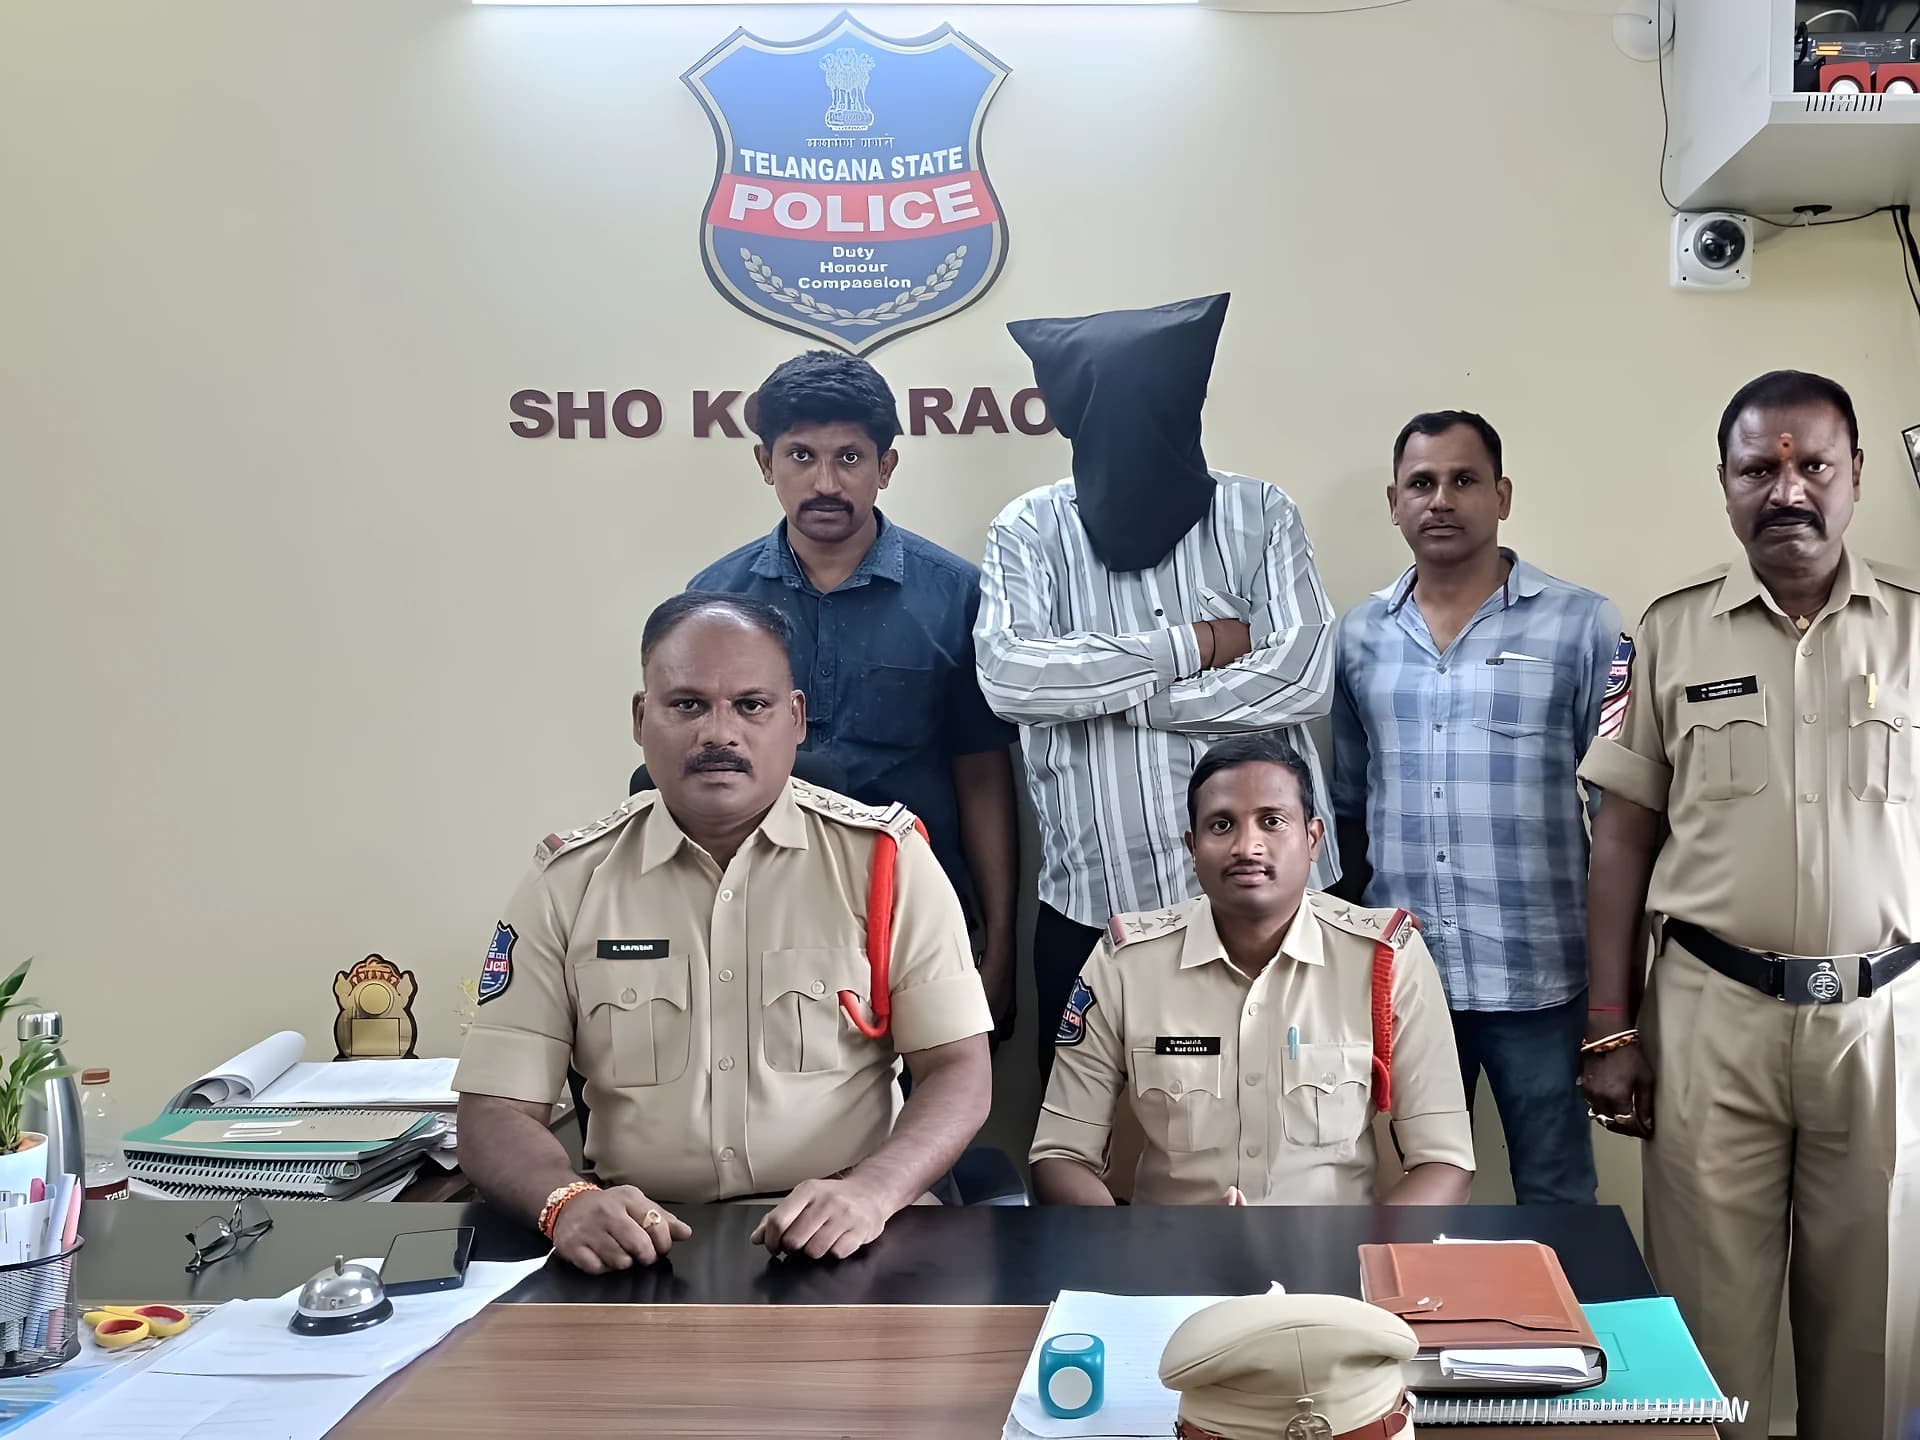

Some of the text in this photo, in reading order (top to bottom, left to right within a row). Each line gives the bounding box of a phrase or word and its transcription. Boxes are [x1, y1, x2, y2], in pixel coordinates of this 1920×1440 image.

[741, 147, 963, 181] TELANGANA STATE
[729, 181, 980, 232] POLICE
[832, 246, 875, 260] Duty
[819, 262, 888, 274] Honour
[798, 277, 912, 291] Compassion
[509, 389, 662, 438] SHO
